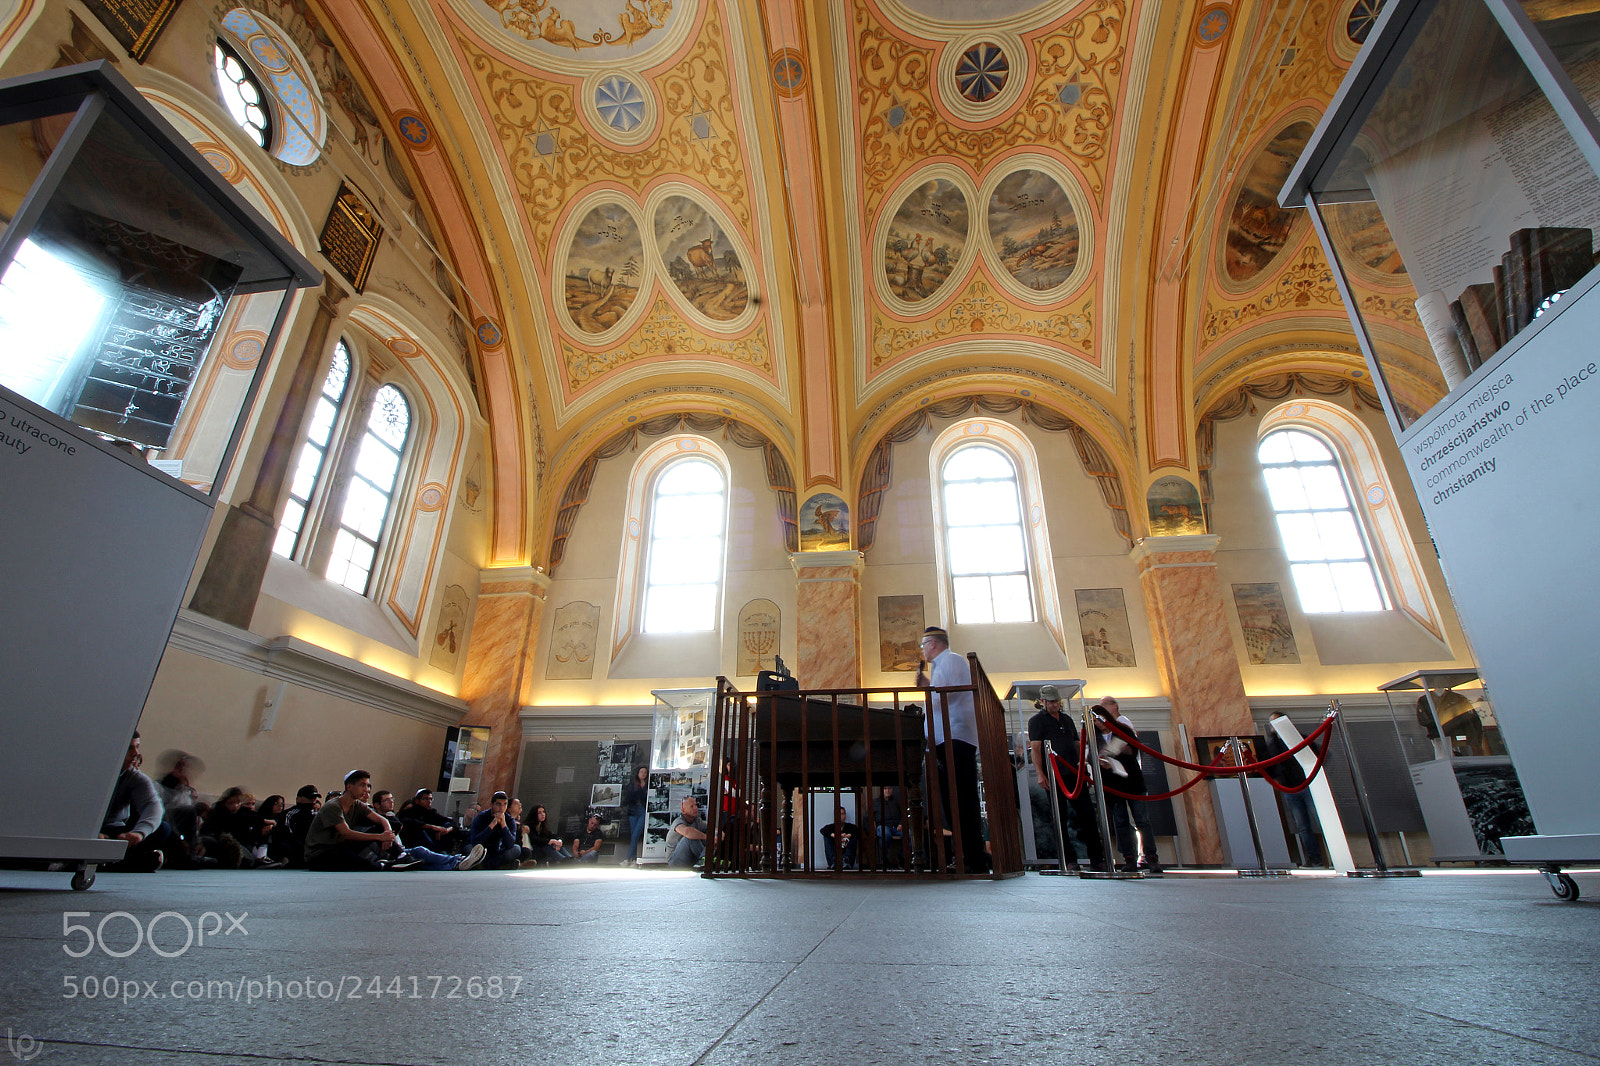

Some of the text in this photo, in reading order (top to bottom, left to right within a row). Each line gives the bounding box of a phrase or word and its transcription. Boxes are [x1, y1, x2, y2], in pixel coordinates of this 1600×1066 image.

[10, 416, 76, 456] utracone
[1413, 373, 1514, 455] wspólnota miejsca
[1420, 400, 1511, 471] chrześcijaństwo
[1426, 362, 1598, 489] commonwealth of the place
[1433, 457, 1497, 505] christianity
